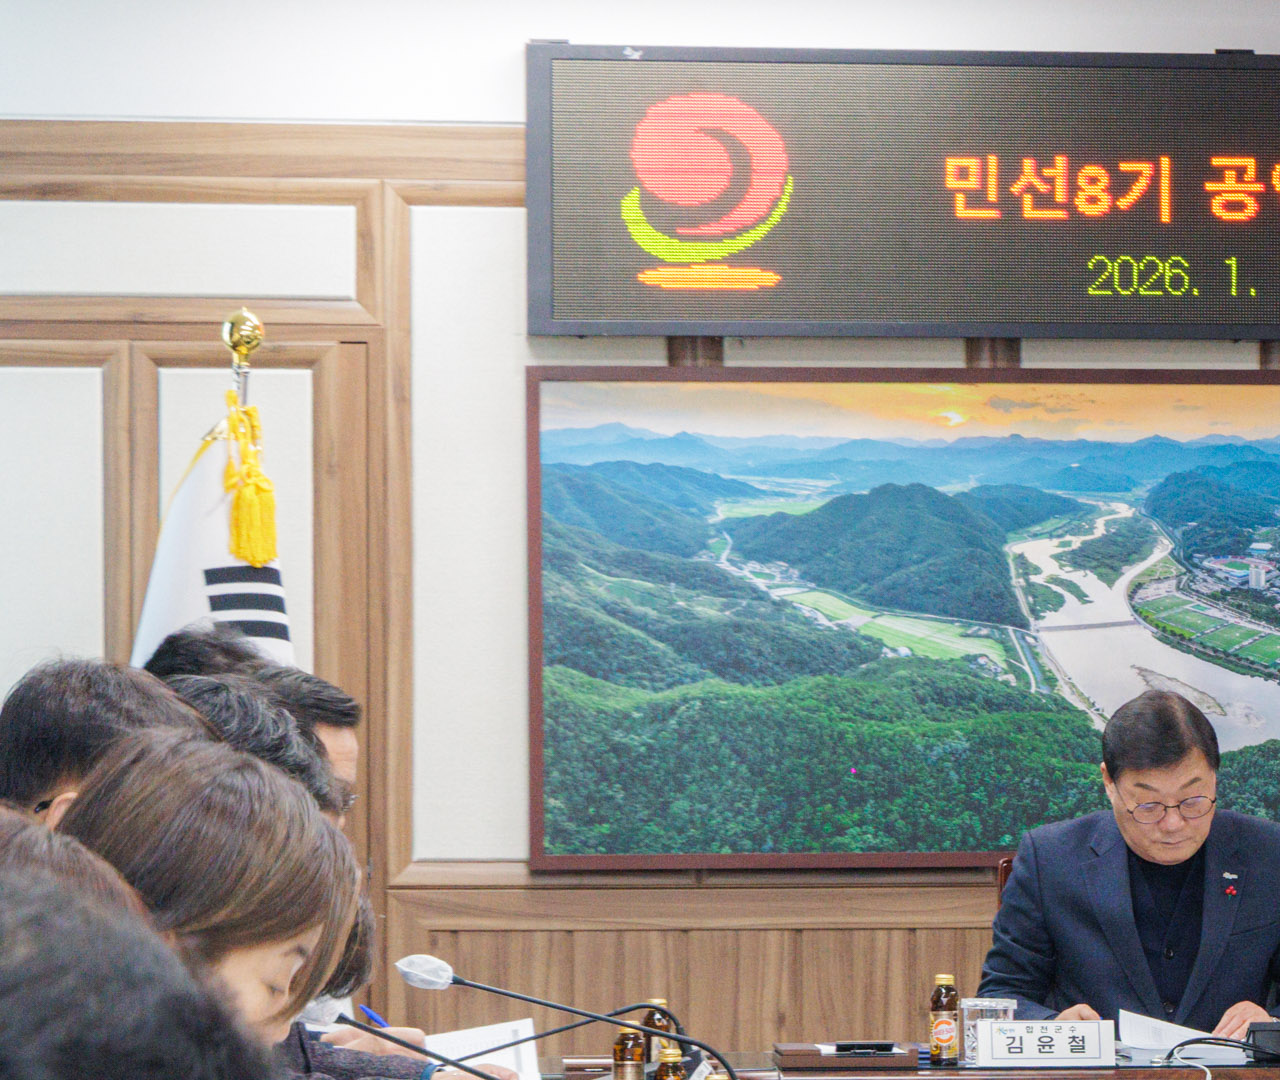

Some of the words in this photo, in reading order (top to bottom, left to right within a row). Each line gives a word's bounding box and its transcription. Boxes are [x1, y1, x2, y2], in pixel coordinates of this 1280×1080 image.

[944, 153, 1173, 224] 민선8기
[1088, 255, 1199, 297] 2026.
[1005, 1035, 1086, 1054] 김윤철
